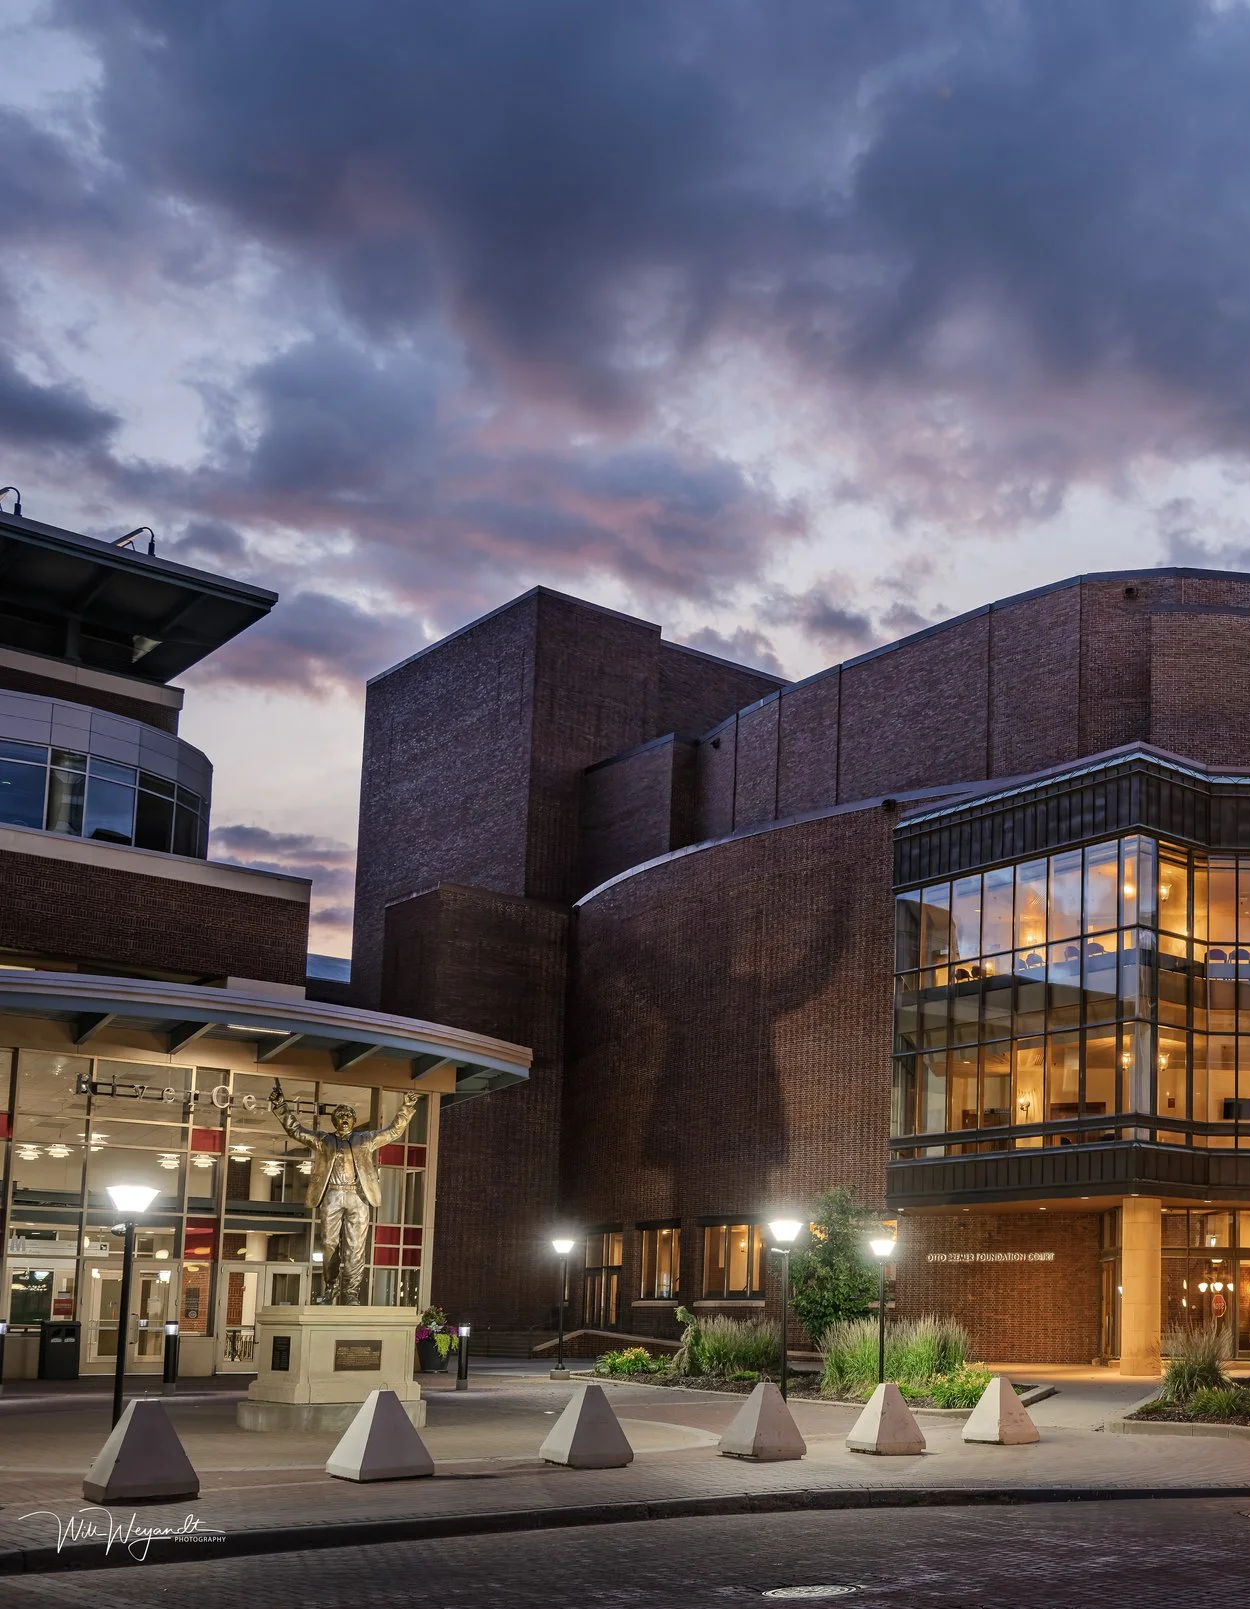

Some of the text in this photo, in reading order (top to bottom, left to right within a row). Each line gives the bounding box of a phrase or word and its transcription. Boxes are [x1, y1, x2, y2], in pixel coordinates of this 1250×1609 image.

[927, 1253, 947, 1262] OTTO
[976, 1252, 1026, 1261] FOUNDATION
[1028, 1252, 1056, 1261] COURT
